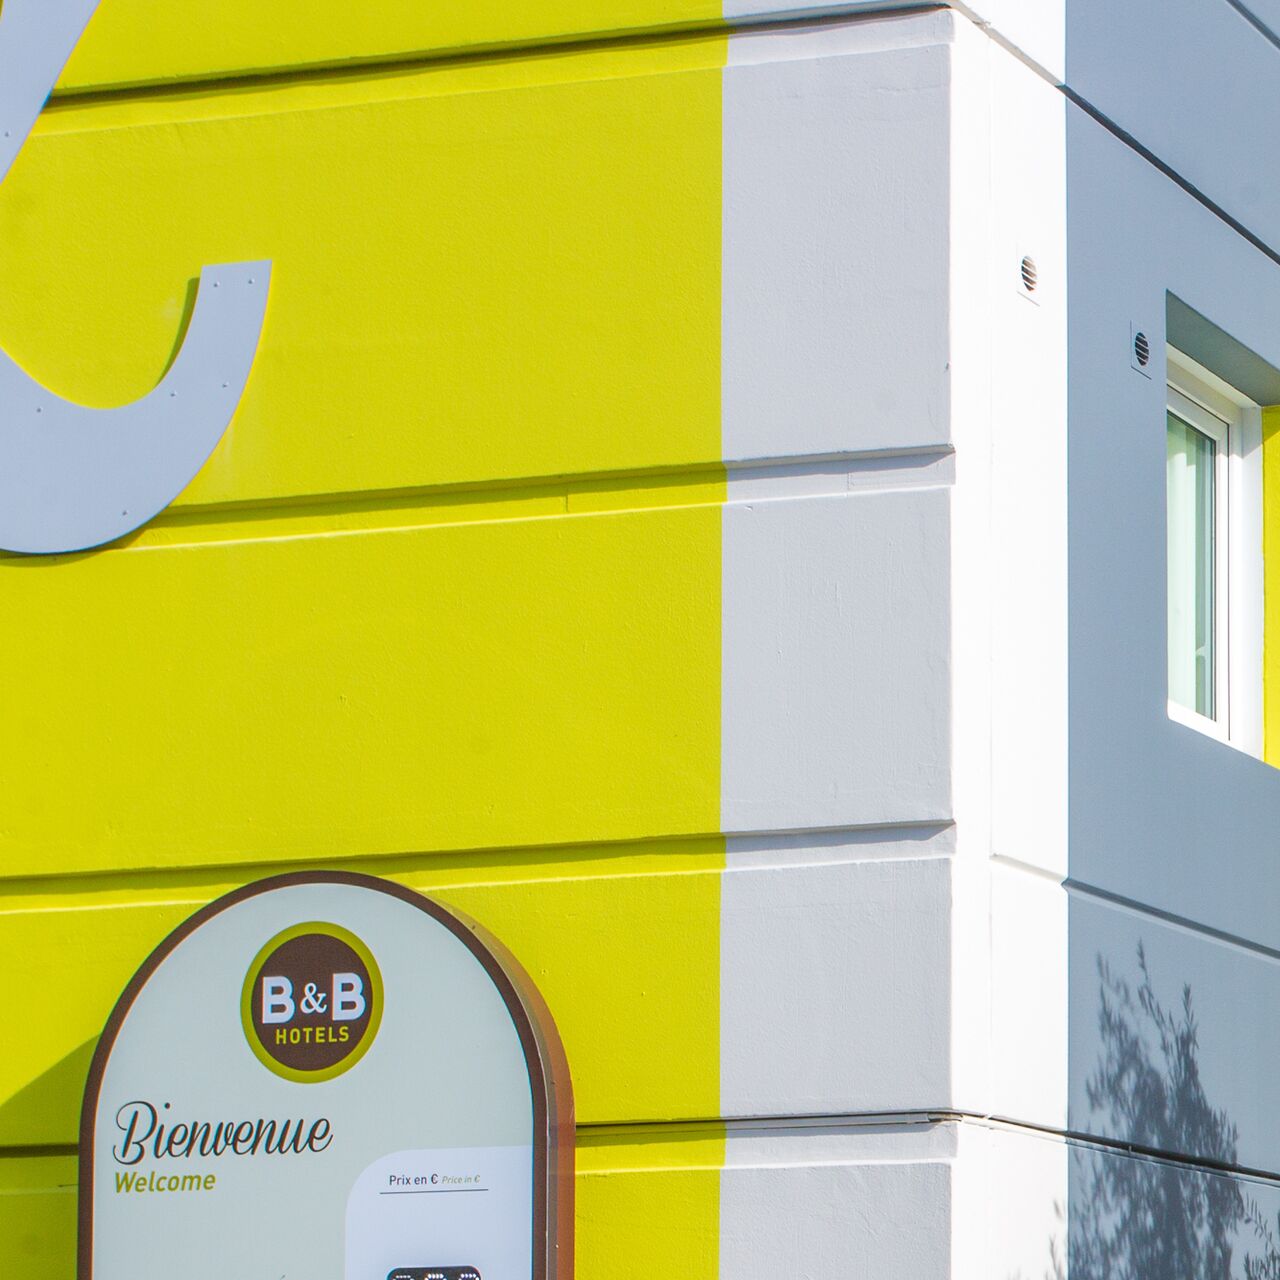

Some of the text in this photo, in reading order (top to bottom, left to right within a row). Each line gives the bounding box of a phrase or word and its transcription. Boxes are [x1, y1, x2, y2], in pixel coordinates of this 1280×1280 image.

[261, 972, 366, 1024] B&B
[275, 1026, 350, 1044] HOTELS
[112, 1101, 334, 1165] Bienvenue
[114, 1171, 216, 1194] Welcome
[389, 1174, 438, 1186] Prix en €
